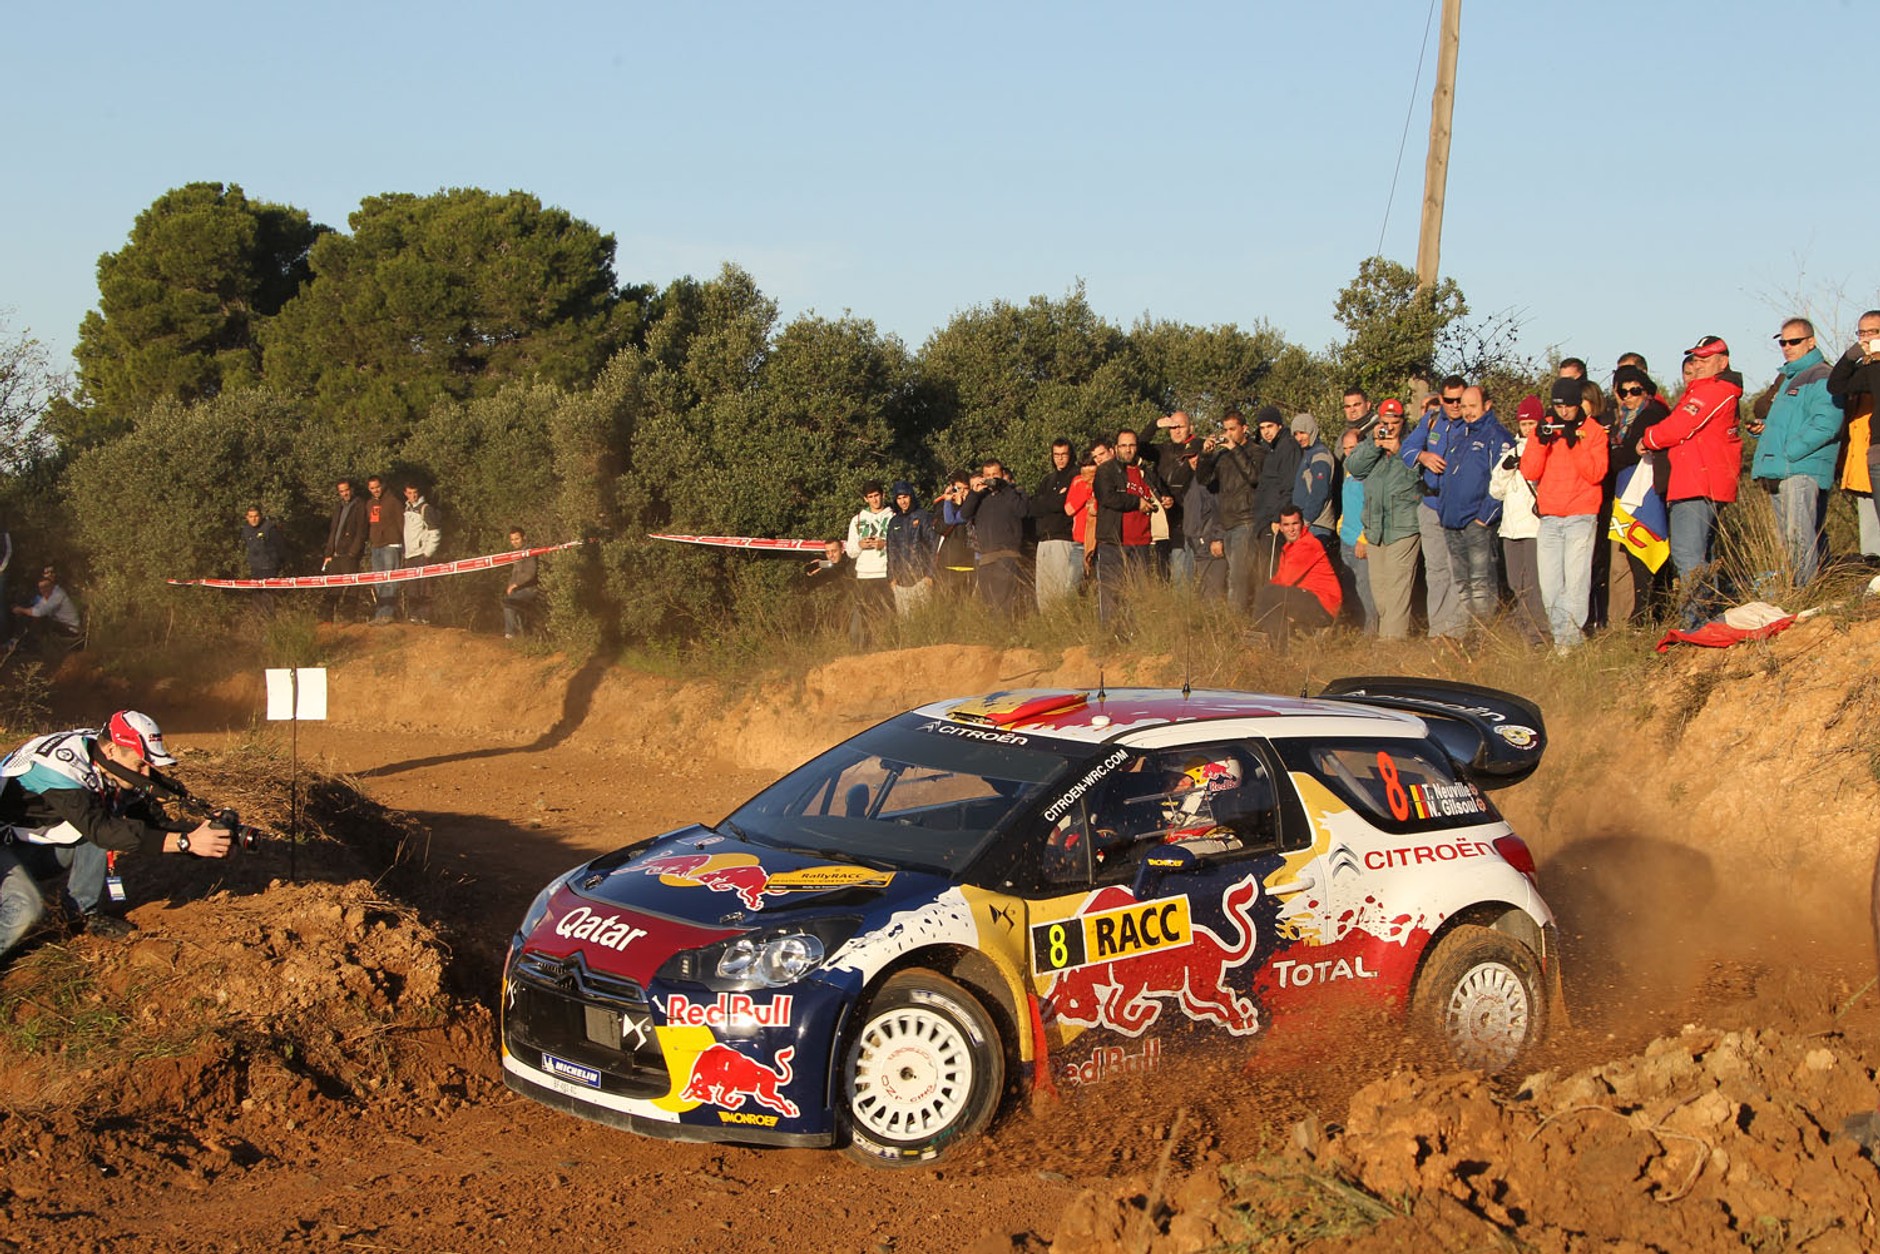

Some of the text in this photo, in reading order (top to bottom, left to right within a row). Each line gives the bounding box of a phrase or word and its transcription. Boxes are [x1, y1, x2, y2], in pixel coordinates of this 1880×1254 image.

[1044, 749, 1130, 822] CITROEN-WRC.COM
[1376, 751, 1410, 822] 8
[1421, 781, 1472, 800] T. Neuville
[1427, 797, 1479, 817] N. Gilsoul
[1364, 837, 1498, 870] CITROËN
[555, 907, 648, 951] Qatar
[1049, 903, 1181, 968] 8 RACC
[1272, 956, 1378, 989] TOTAL
[667, 993, 793, 1027] Red Bull
[554, 1062, 598, 1082] MICHELIN
[722, 1111, 775, 1127] MONROE
